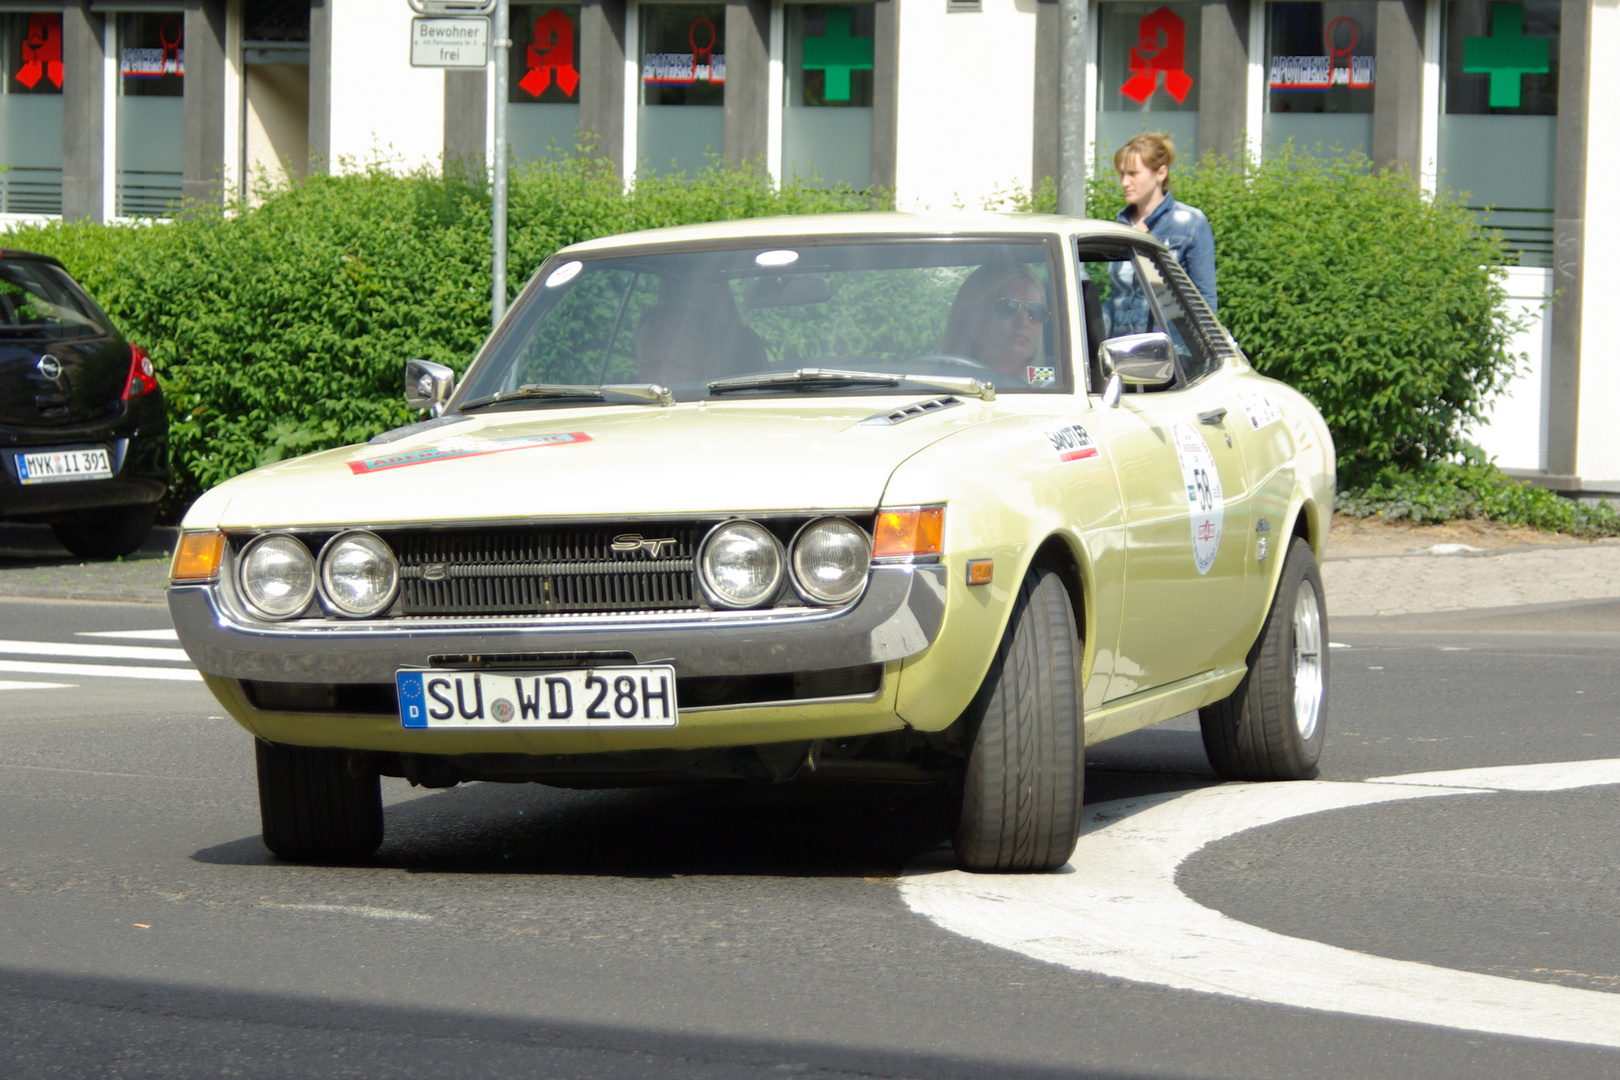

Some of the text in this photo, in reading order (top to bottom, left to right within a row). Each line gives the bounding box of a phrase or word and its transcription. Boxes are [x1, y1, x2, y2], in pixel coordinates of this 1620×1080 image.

[420, 23, 480, 38] Bewohner
[440, 47, 460, 60] frei
[642, 53, 694, 78] APOTHEKE
[1270, 56, 1331, 83] APOTHEKE
[1331, 68, 1350, 84] AM
[1044, 425, 1093, 451] SANDTLER
[26, 455, 54, 475] MYK
[63, 454, 80, 472] II
[82, 452, 108, 471] 391
[1193, 468, 1213, 512] 58
[610, 533, 677, 557] ST
[427, 677, 485, 720] SU
[515, 677, 573, 720] WD
[585, 675, 671, 720] 28H
[409, 705, 419, 718] D
